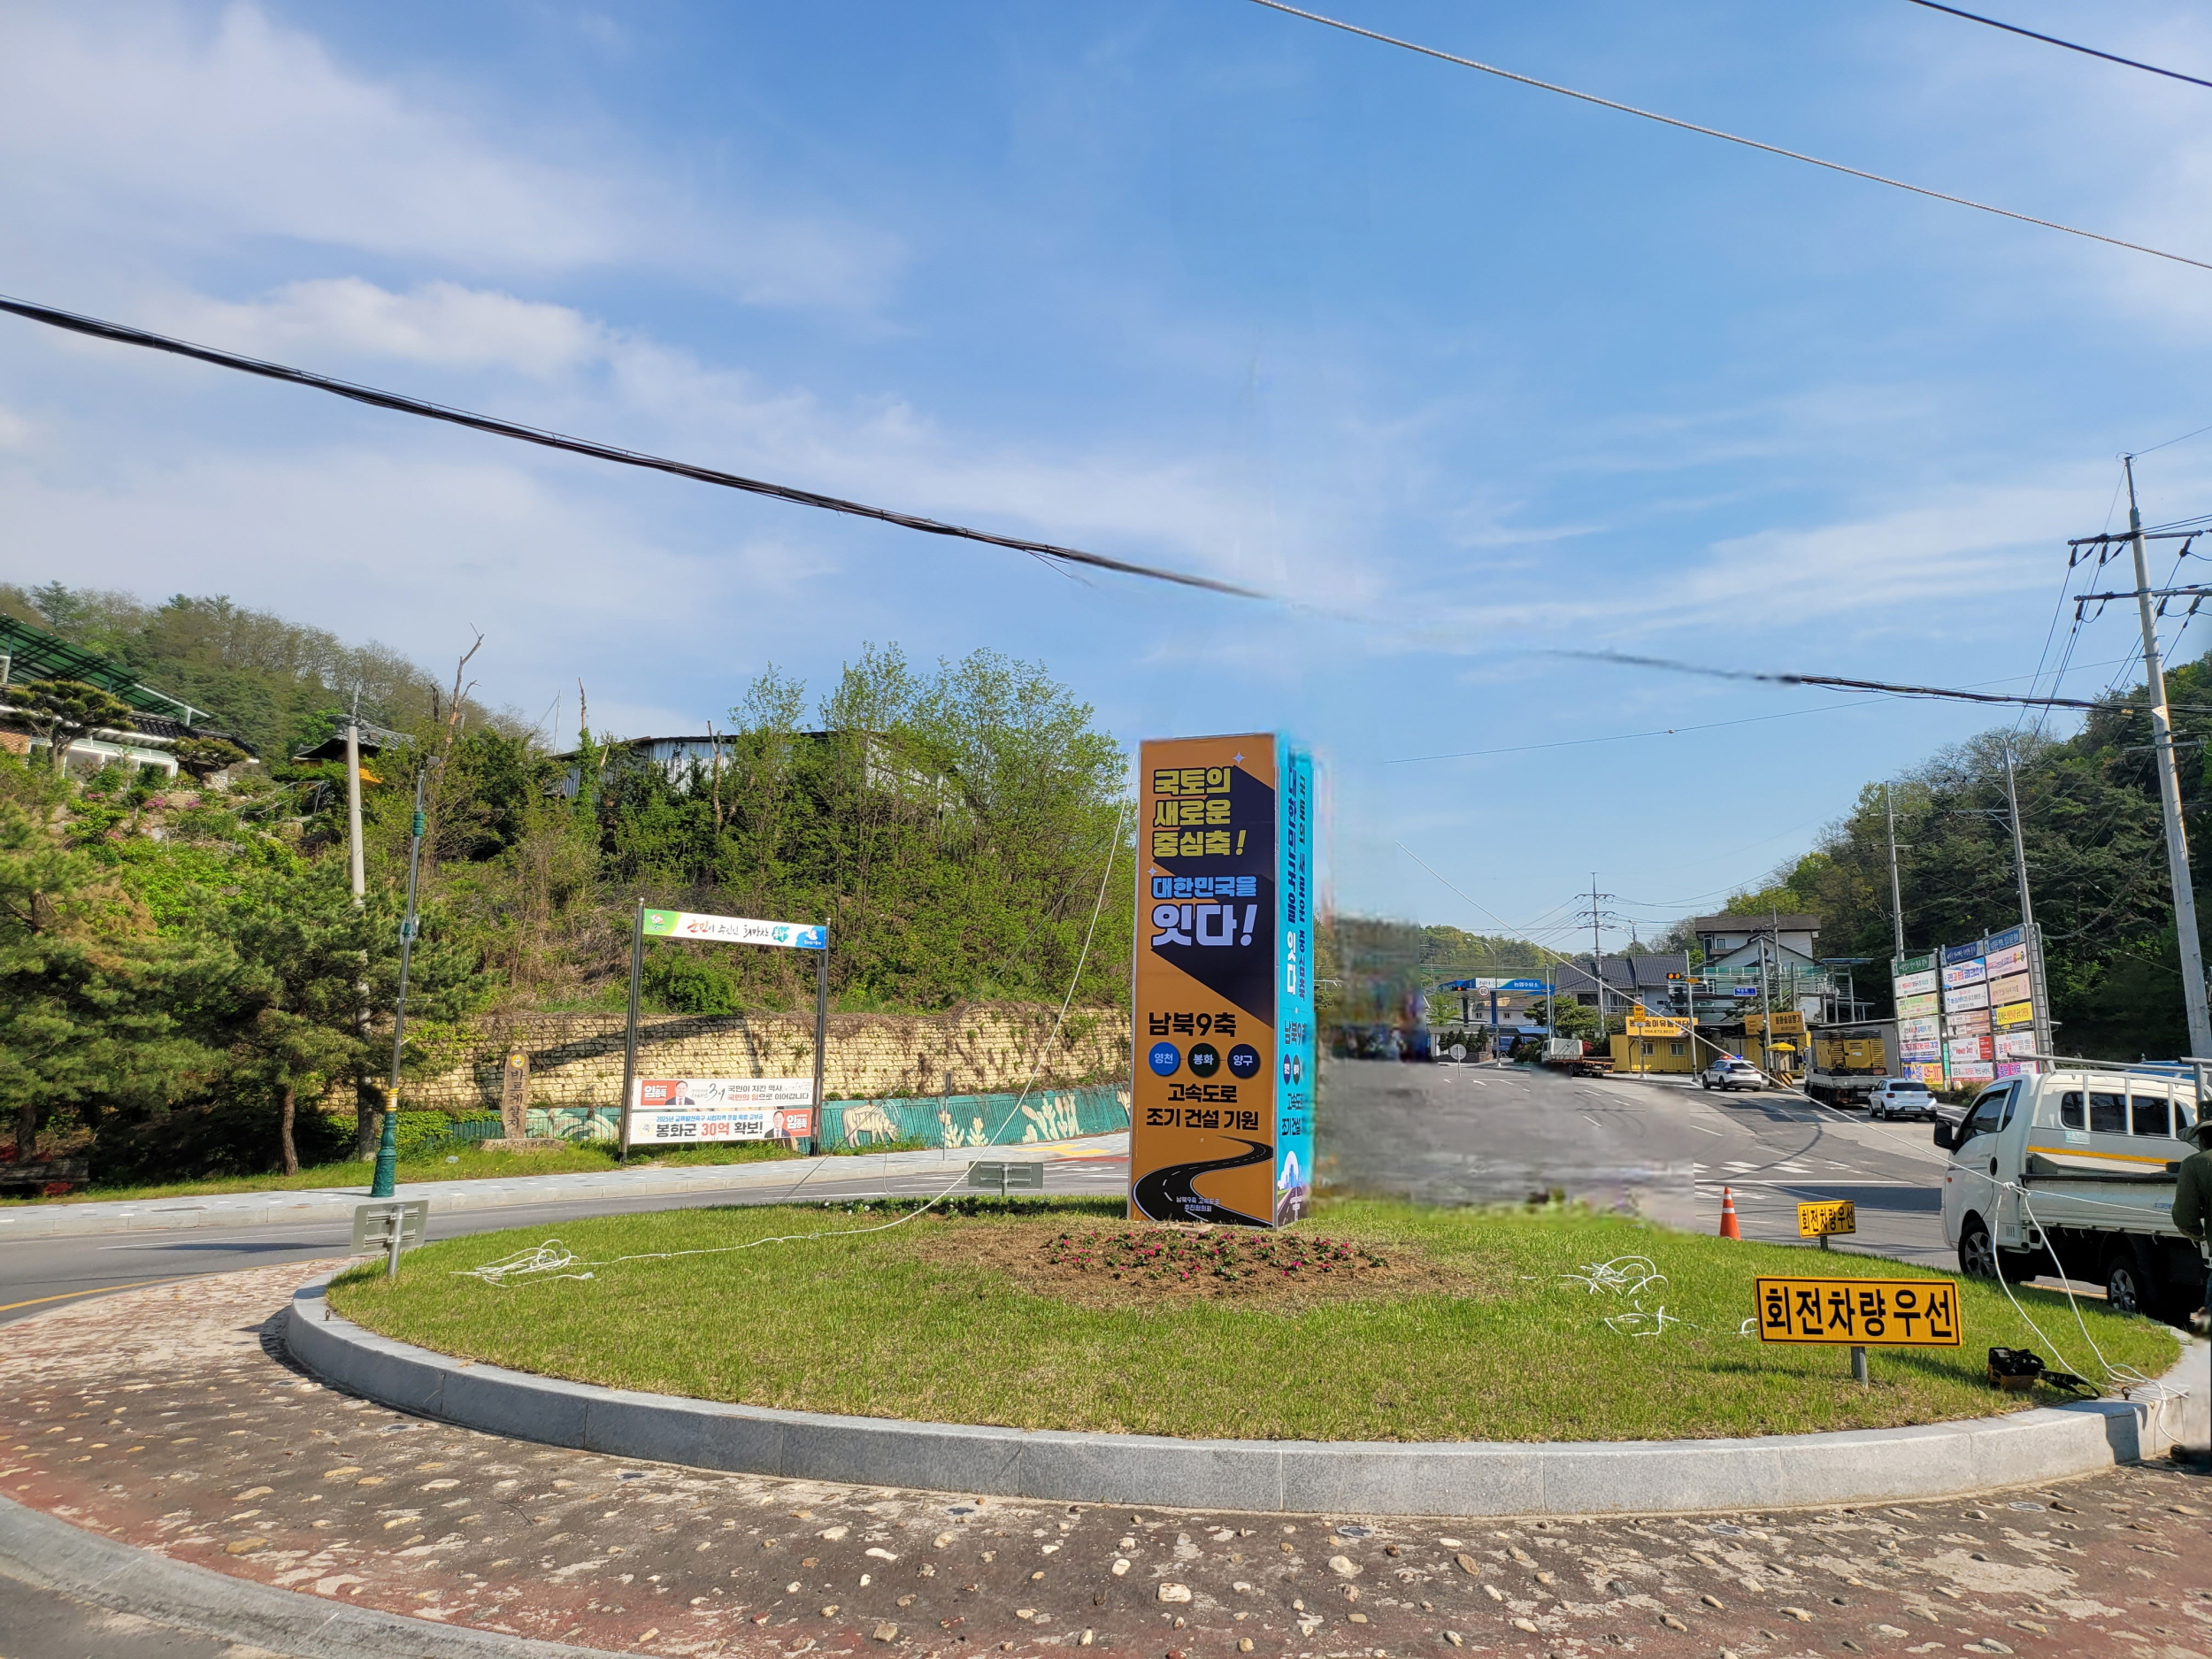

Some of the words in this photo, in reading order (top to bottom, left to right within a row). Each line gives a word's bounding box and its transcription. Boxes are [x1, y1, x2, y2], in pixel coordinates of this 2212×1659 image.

[1153, 767, 1231, 795] 국토의
[1153, 799, 1231, 827] 새로운
[1152, 875, 1257, 899] 대한민국을
[1151, 903, 1258, 947] 잇다!
[1148, 1011, 1236, 1037] 남북9축
[1154, 1053, 1173, 1064] 영천
[1193, 1054, 1214, 1066] 봉화
[1233, 1055, 1253, 1067] 양구
[506, 1068, 526, 1130] 바르게살자
[1167, 1083, 1238, 1103] 고속도로
[656, 1123, 697, 1138] 봉화군
[701, 1122, 730, 1136] 30억
[733, 1121, 763, 1135] 확보!
[1146, 1108, 1180, 1127] 조기
[1184, 1109, 1219, 1129] 건설
[1224, 1110, 1259, 1131] 기원
[1801, 1205, 1854, 1232] 회전차량우선
[1765, 1286, 1952, 1338] 회전차량우선
